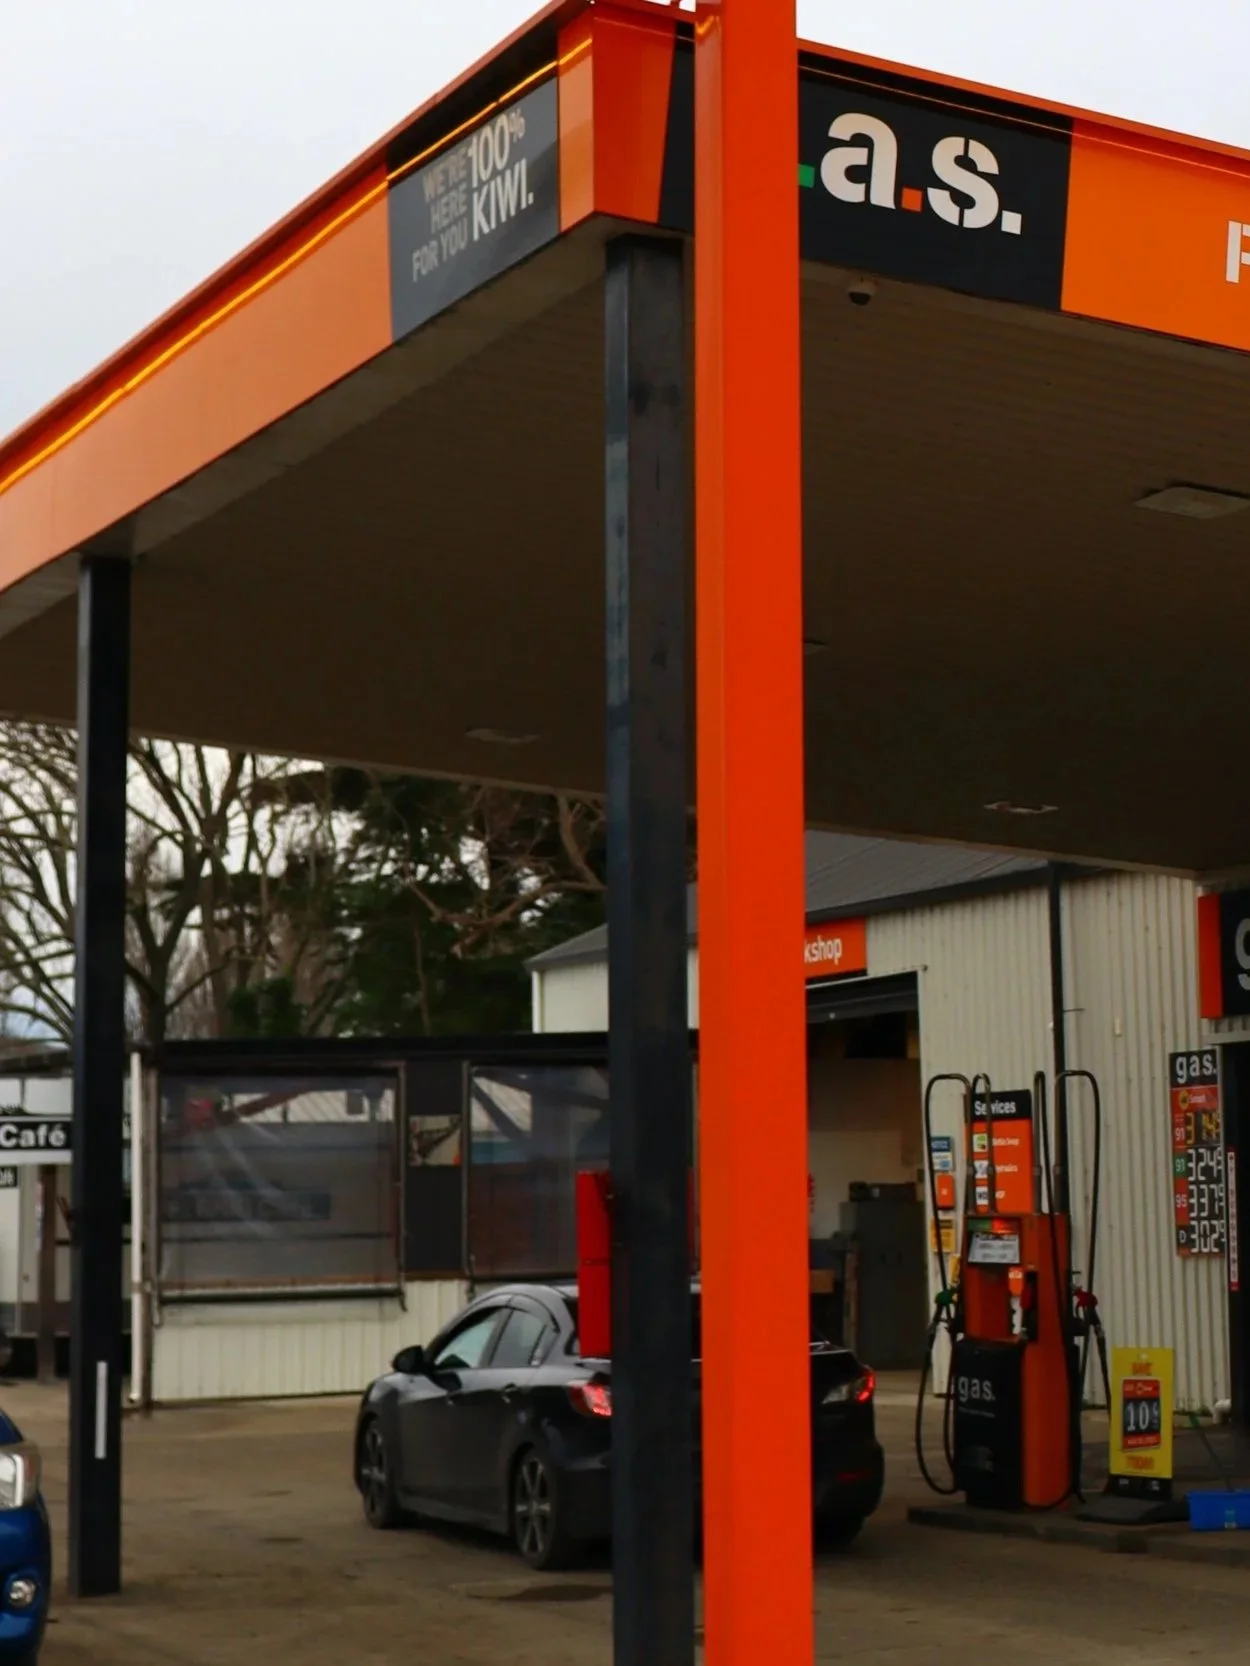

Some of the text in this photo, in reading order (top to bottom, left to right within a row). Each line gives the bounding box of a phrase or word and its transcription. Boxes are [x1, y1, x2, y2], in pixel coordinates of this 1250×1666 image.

[467, 107, 526, 189] 100%
[412, 217, 468, 282] FOR YOU
[974, 1099, 1017, 1116] Sevices
[0, 1123, 67, 1149] Café
[1179, 1229, 1187, 1243] D
